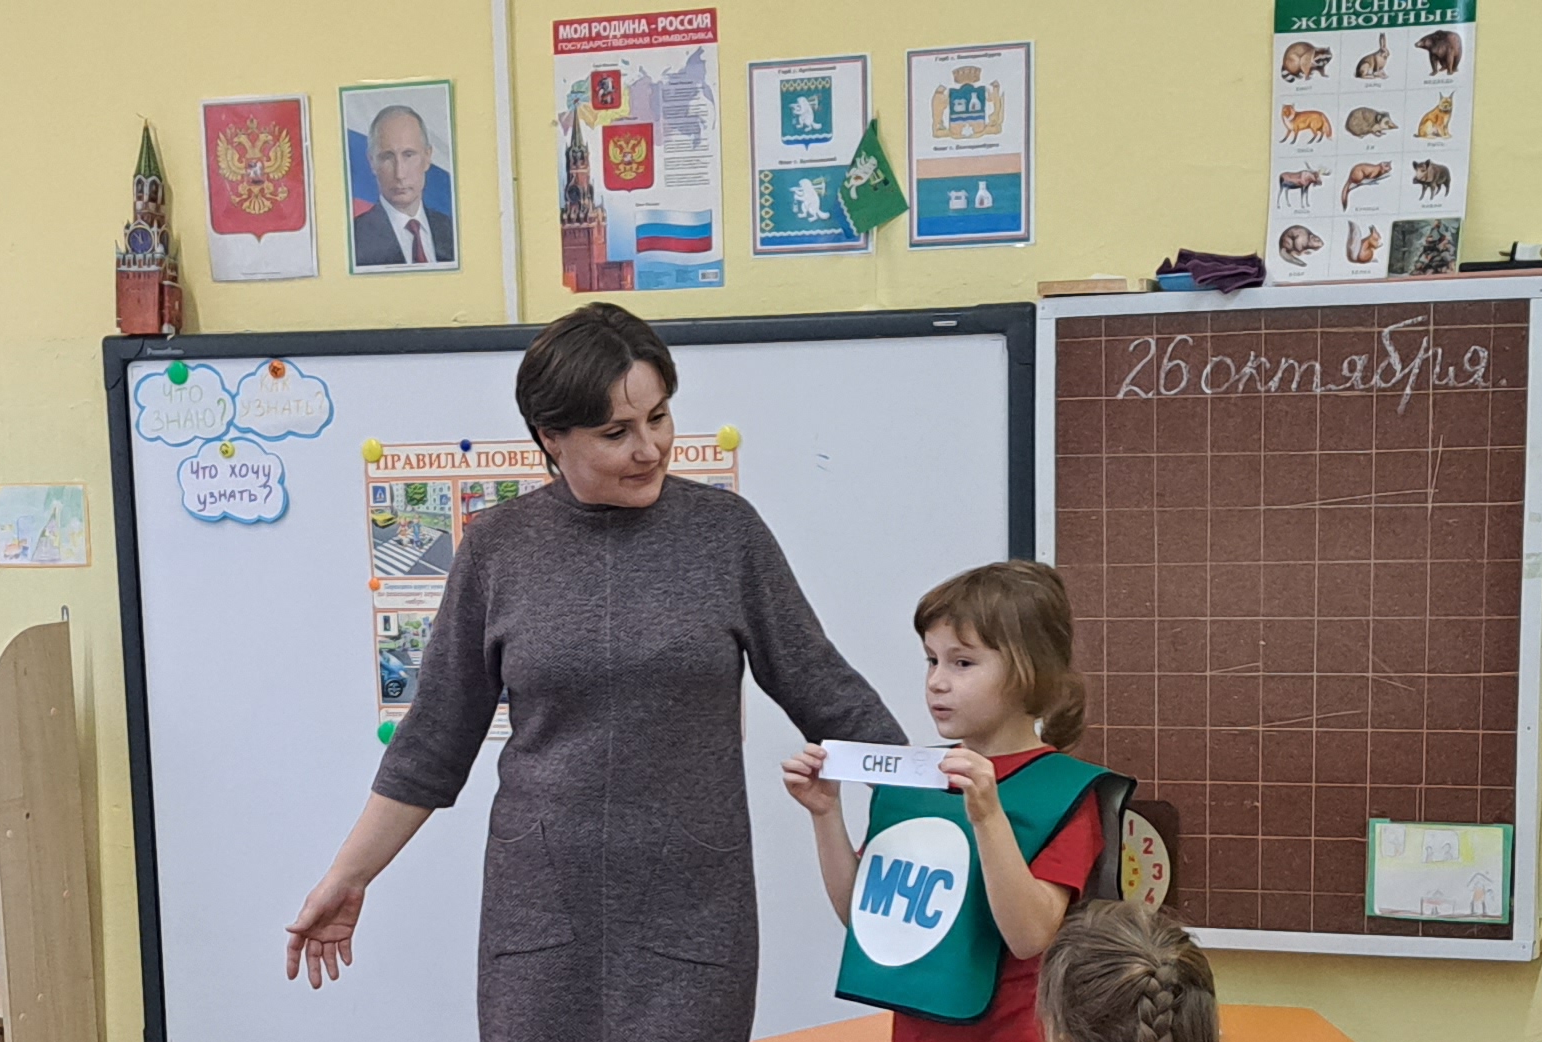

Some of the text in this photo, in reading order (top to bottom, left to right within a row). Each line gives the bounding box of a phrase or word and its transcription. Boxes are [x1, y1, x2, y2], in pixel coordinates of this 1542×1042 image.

[1322, 0, 1430, 15] ЛЕСНЫЕ
[559, 23, 589, 39] МОЯ
[592, 18, 648, 38] РОДИНА
[658, 13, 711, 31] РОССИЯ
[1291, 9, 1460, 30] ЖИВОТНЫЕ
[558, 32, 713, 51] ГОСУДАРСТВЕННАЯ СИМВОЛИКА
[1118, 335, 1193, 399] 26
[162, 384, 203, 403] ЧТО
[375, 452, 472, 471] ПРАВИЛА
[673, 445, 724, 462] РОГЕ
[862, 754, 903, 774] СНЕГ
[1128, 819, 1134, 836] 1
[1142, 837, 1153, 855] 2
[1152, 863, 1163, 880] 3
[859, 854, 954, 929] МЧС
